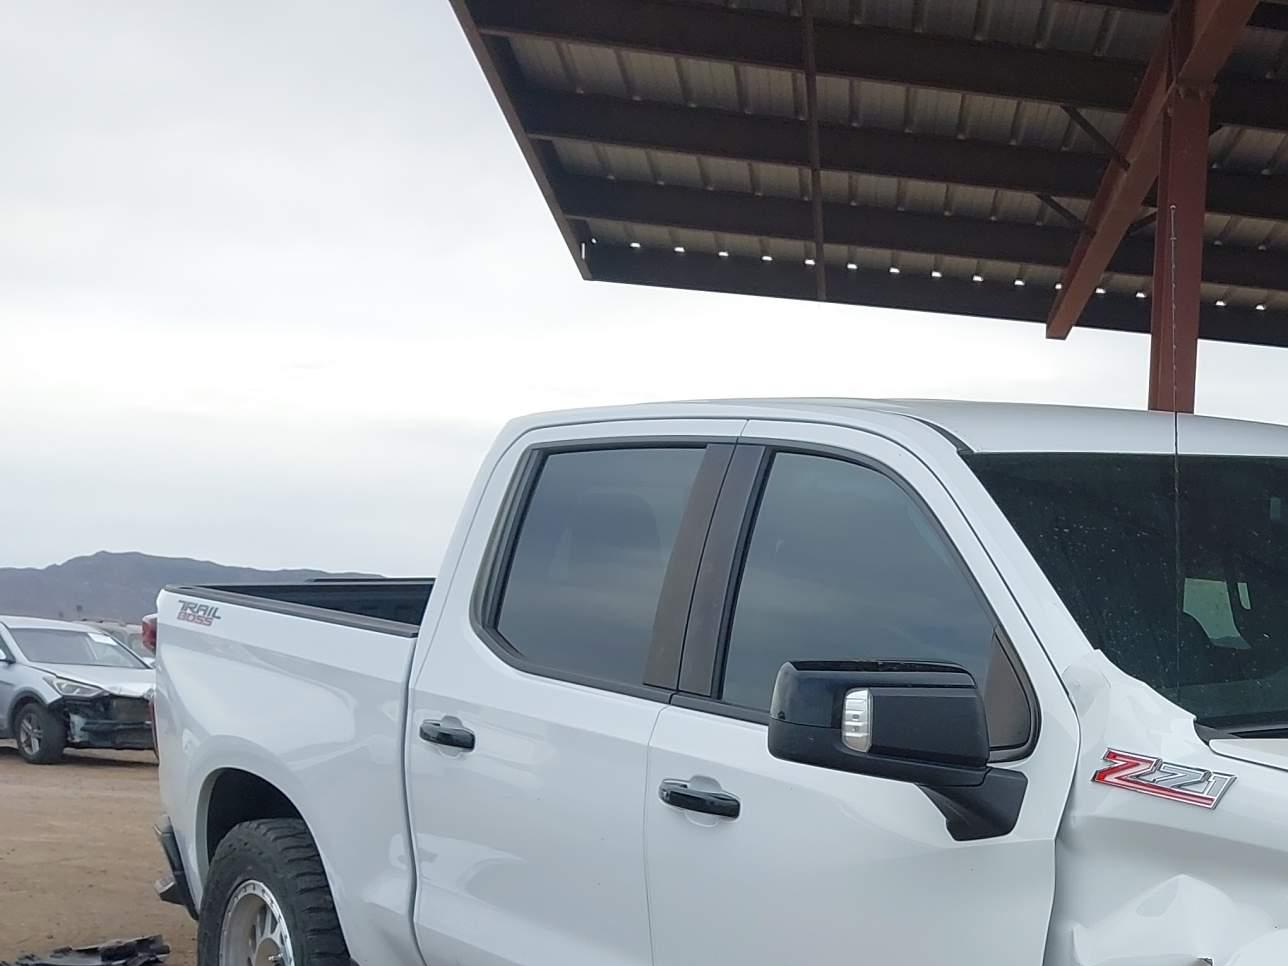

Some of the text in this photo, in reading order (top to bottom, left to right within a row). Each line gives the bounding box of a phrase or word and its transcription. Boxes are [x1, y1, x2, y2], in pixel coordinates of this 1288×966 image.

[176, 612, 214, 626] BOSS
[178, 600, 222, 619] TRAIL
[1090, 748, 1238, 810] Z71
